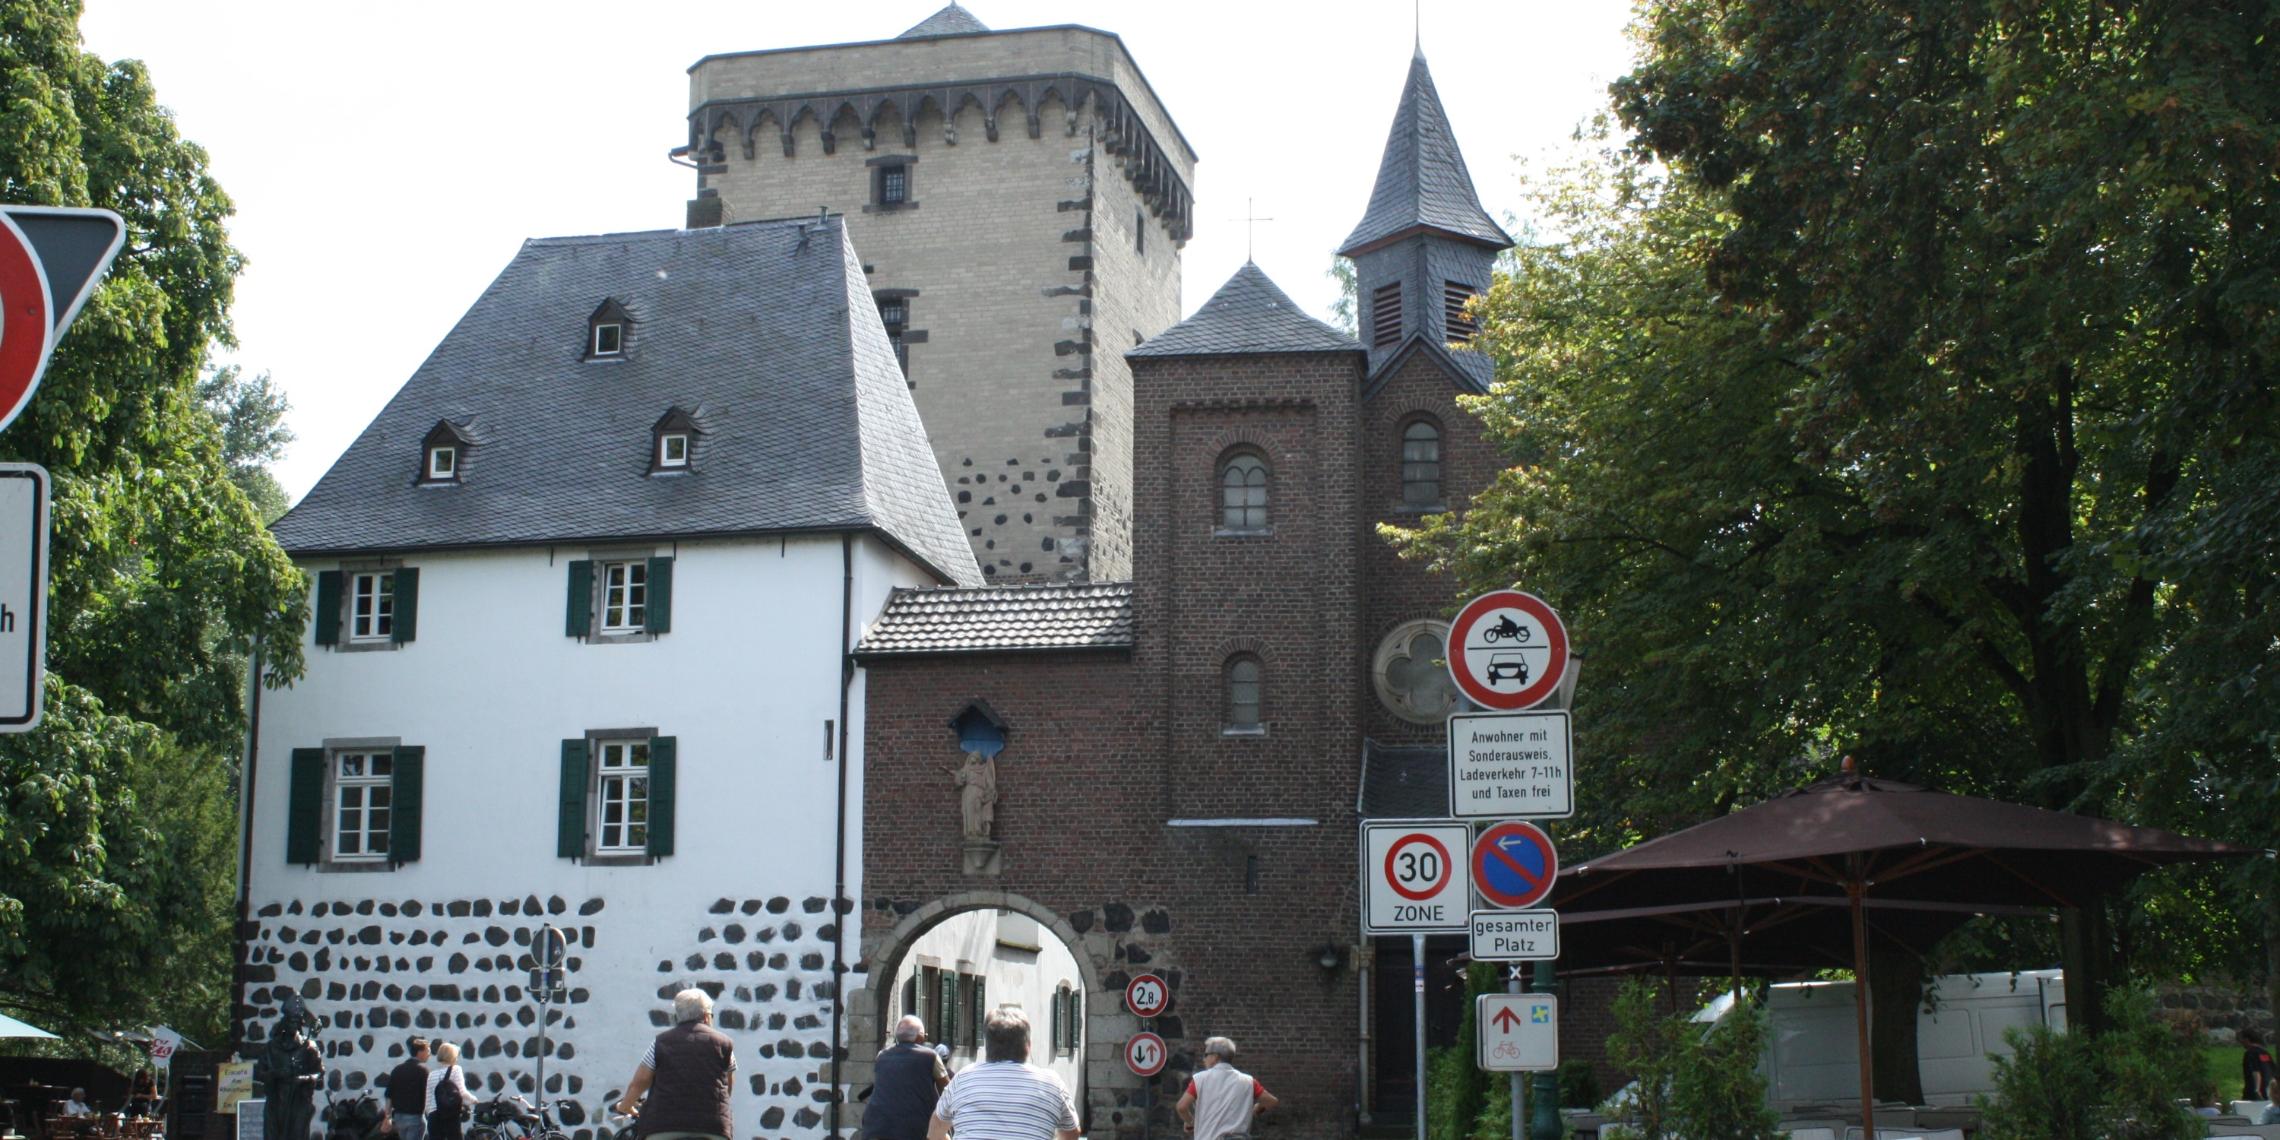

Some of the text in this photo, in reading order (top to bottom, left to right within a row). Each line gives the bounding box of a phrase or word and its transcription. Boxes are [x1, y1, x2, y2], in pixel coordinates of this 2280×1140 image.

[1472, 729, 1547, 743] Anwohner mit
[1460, 766, 1561, 781] Ladeverkehr 7-11h
[1472, 785, 1551, 799] und Taxen frei
[1399, 852, 1437, 882] 30
[1394, 905, 1444, 921] ZONE
[1475, 919, 1552, 936] gesamter
[1494, 938, 1534, 952] Platz
